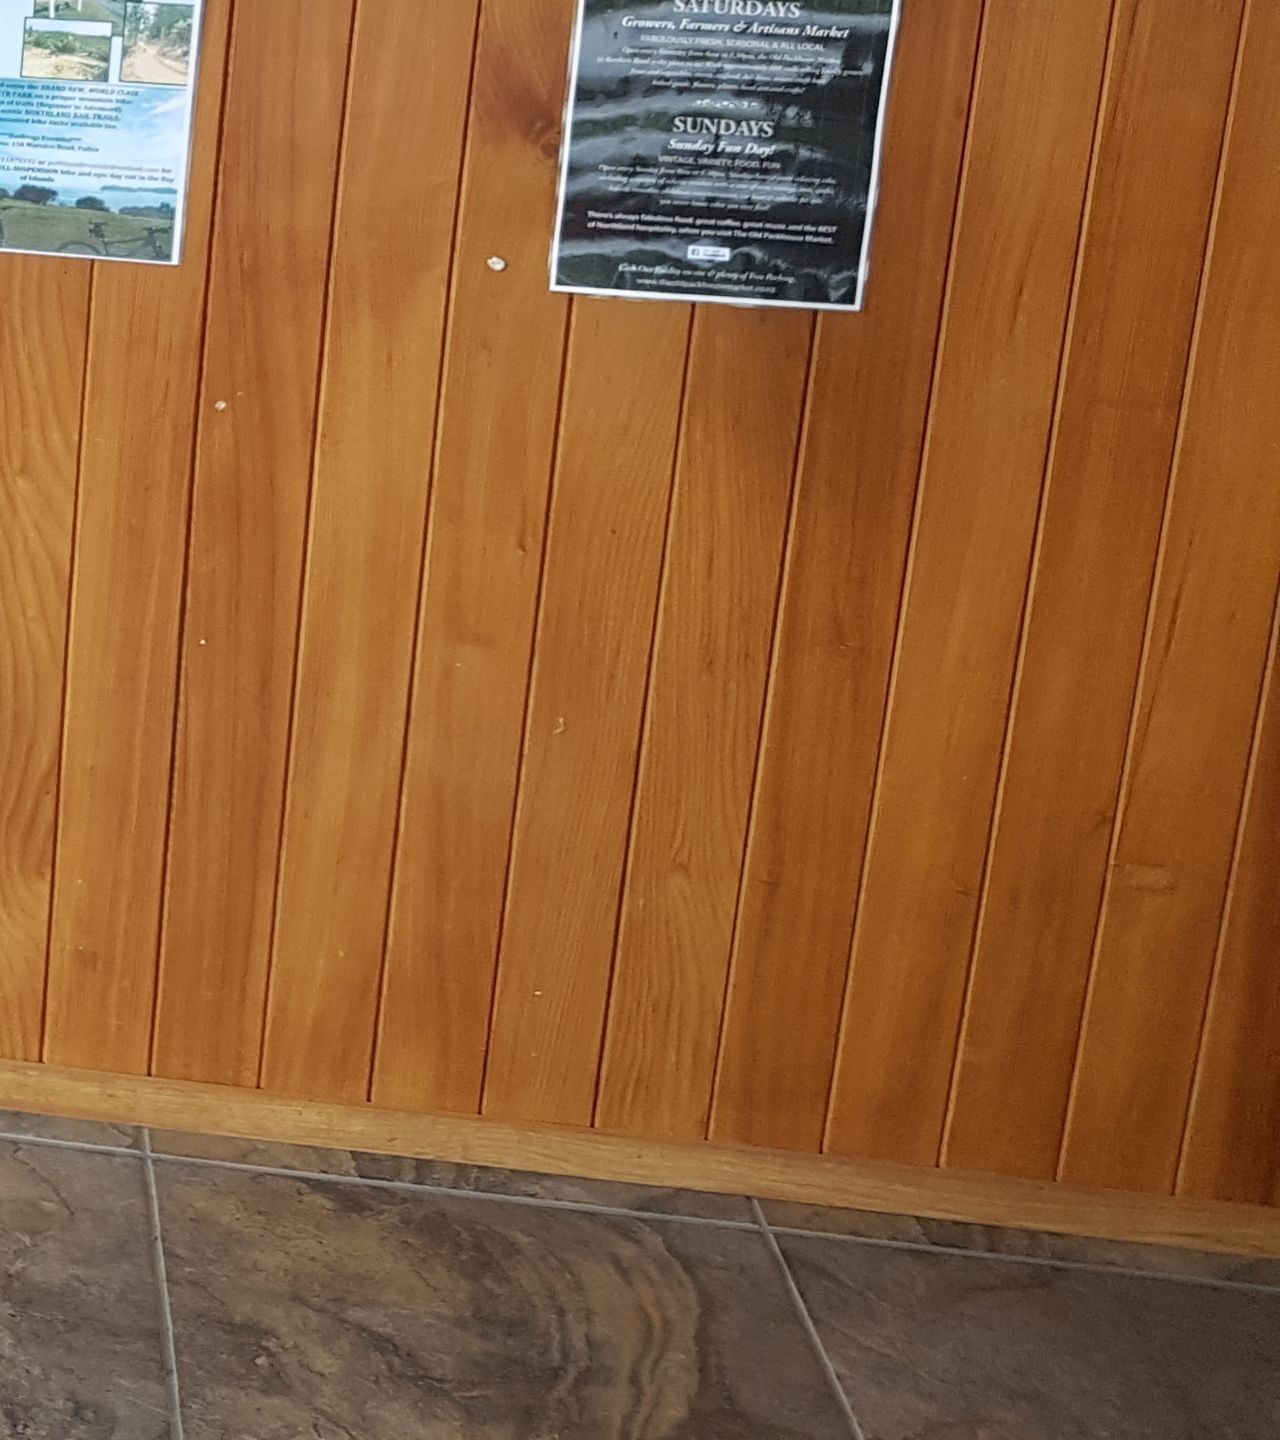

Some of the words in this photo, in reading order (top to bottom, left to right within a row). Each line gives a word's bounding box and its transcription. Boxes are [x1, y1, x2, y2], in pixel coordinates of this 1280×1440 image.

[621, 16, 676, 30] Growers,
[679, 18, 730, 31] Farmers
[732, 21, 747, 32] &
[749, 23, 800, 36] Artisans
[801, 26, 849, 38] Market
[672, 116, 774, 138] SUNDAYS
[667, 138, 713, 154] Sunday
[717, 141, 742, 154] Fun
